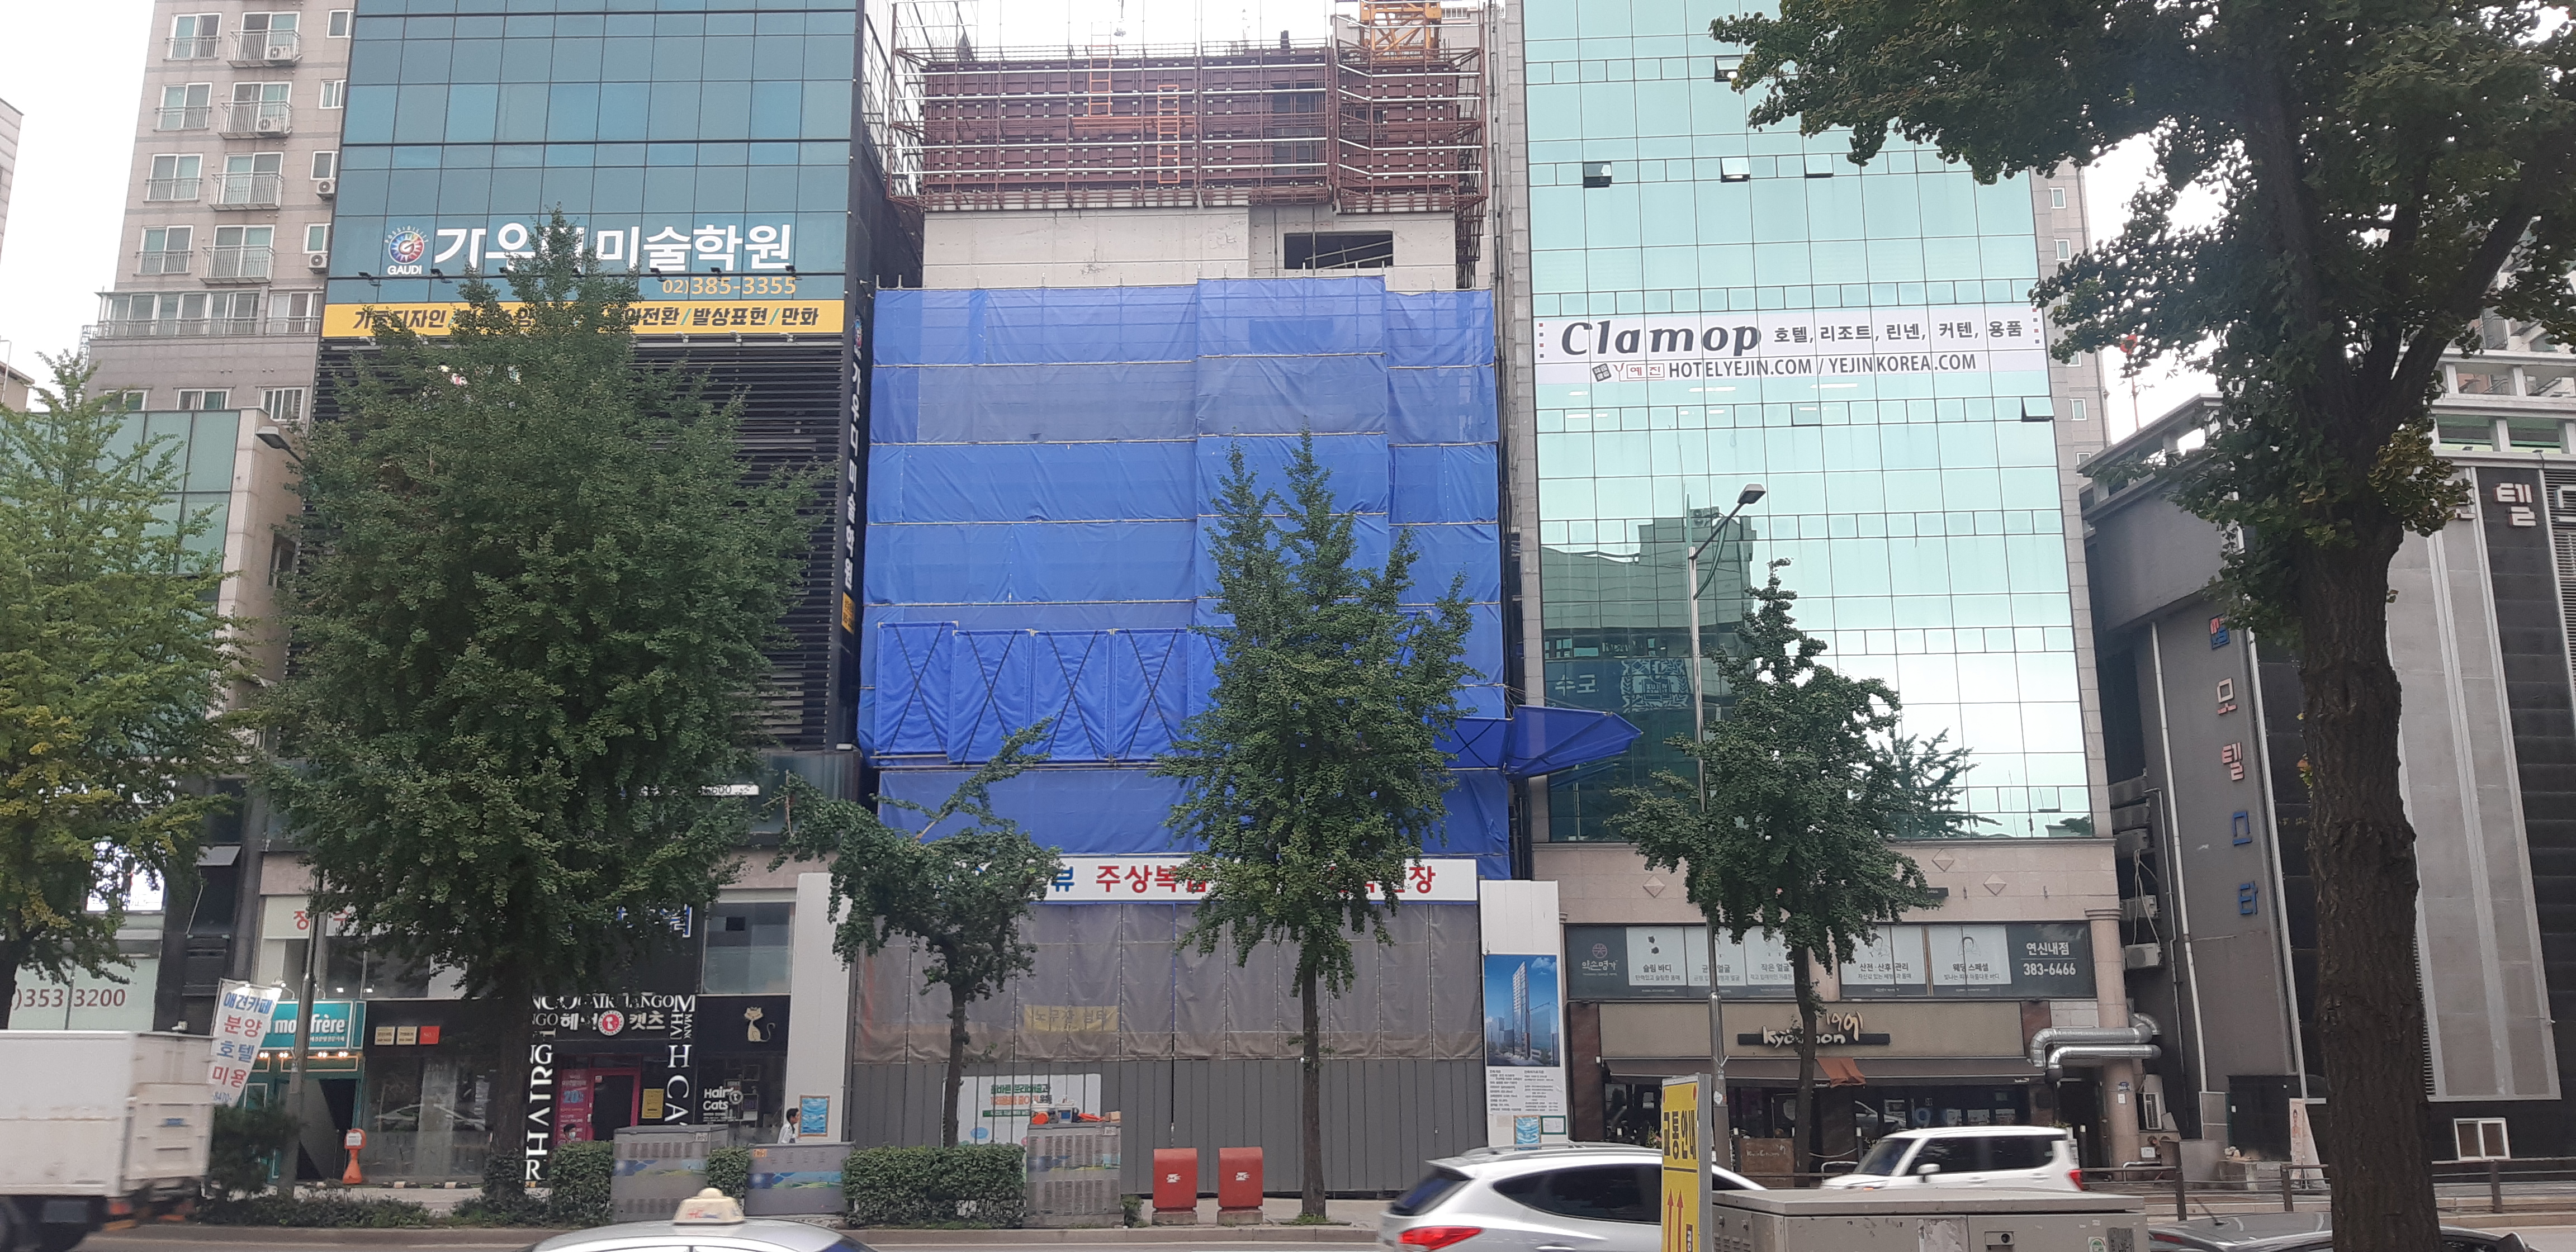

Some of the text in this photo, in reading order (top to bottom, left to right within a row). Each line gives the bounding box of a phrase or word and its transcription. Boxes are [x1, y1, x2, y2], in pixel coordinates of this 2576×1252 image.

[387, 265, 422, 275] GAUDI
[662, 277, 797, 295] 02)385-3355
[1561, 320, 1761, 357] Clamop
[1774, 326, 1814, 343] 호텔,
[1886, 323, 1926, 341] 린넨,
[1938, 321, 1979, 339] 커텐,
[1988, 320, 2023, 338] 용품
[1669, 358, 1812, 378] HOTELYEJIN.COM
[1828, 353, 1977, 374] YEJINKOREA.COM
[2026, 942, 2070, 956] 연신내점
[1581, 960, 1617, 971] 약손명가
[1642, 964, 1672, 973] 슬림 바디
[1717, 964, 1731, 973] 얼굴
[1761, 963, 1775, 972] 작은
[1895, 962, 1909, 971] 관리
[1968, 962, 1989, 972] 스페셜
[2023, 962, 2076, 976] 383-6466
[223, 992, 273, 1014] 애견카페
[224, 1014, 263, 1038] 분양
[629, 1011, 665, 1031] 캣츠
[216, 1040, 255, 1063] 호텔
[212, 1066, 247, 1089] 미용
[704, 1085, 734, 1099] Hair
[703, 1099, 729, 1111] Cats
